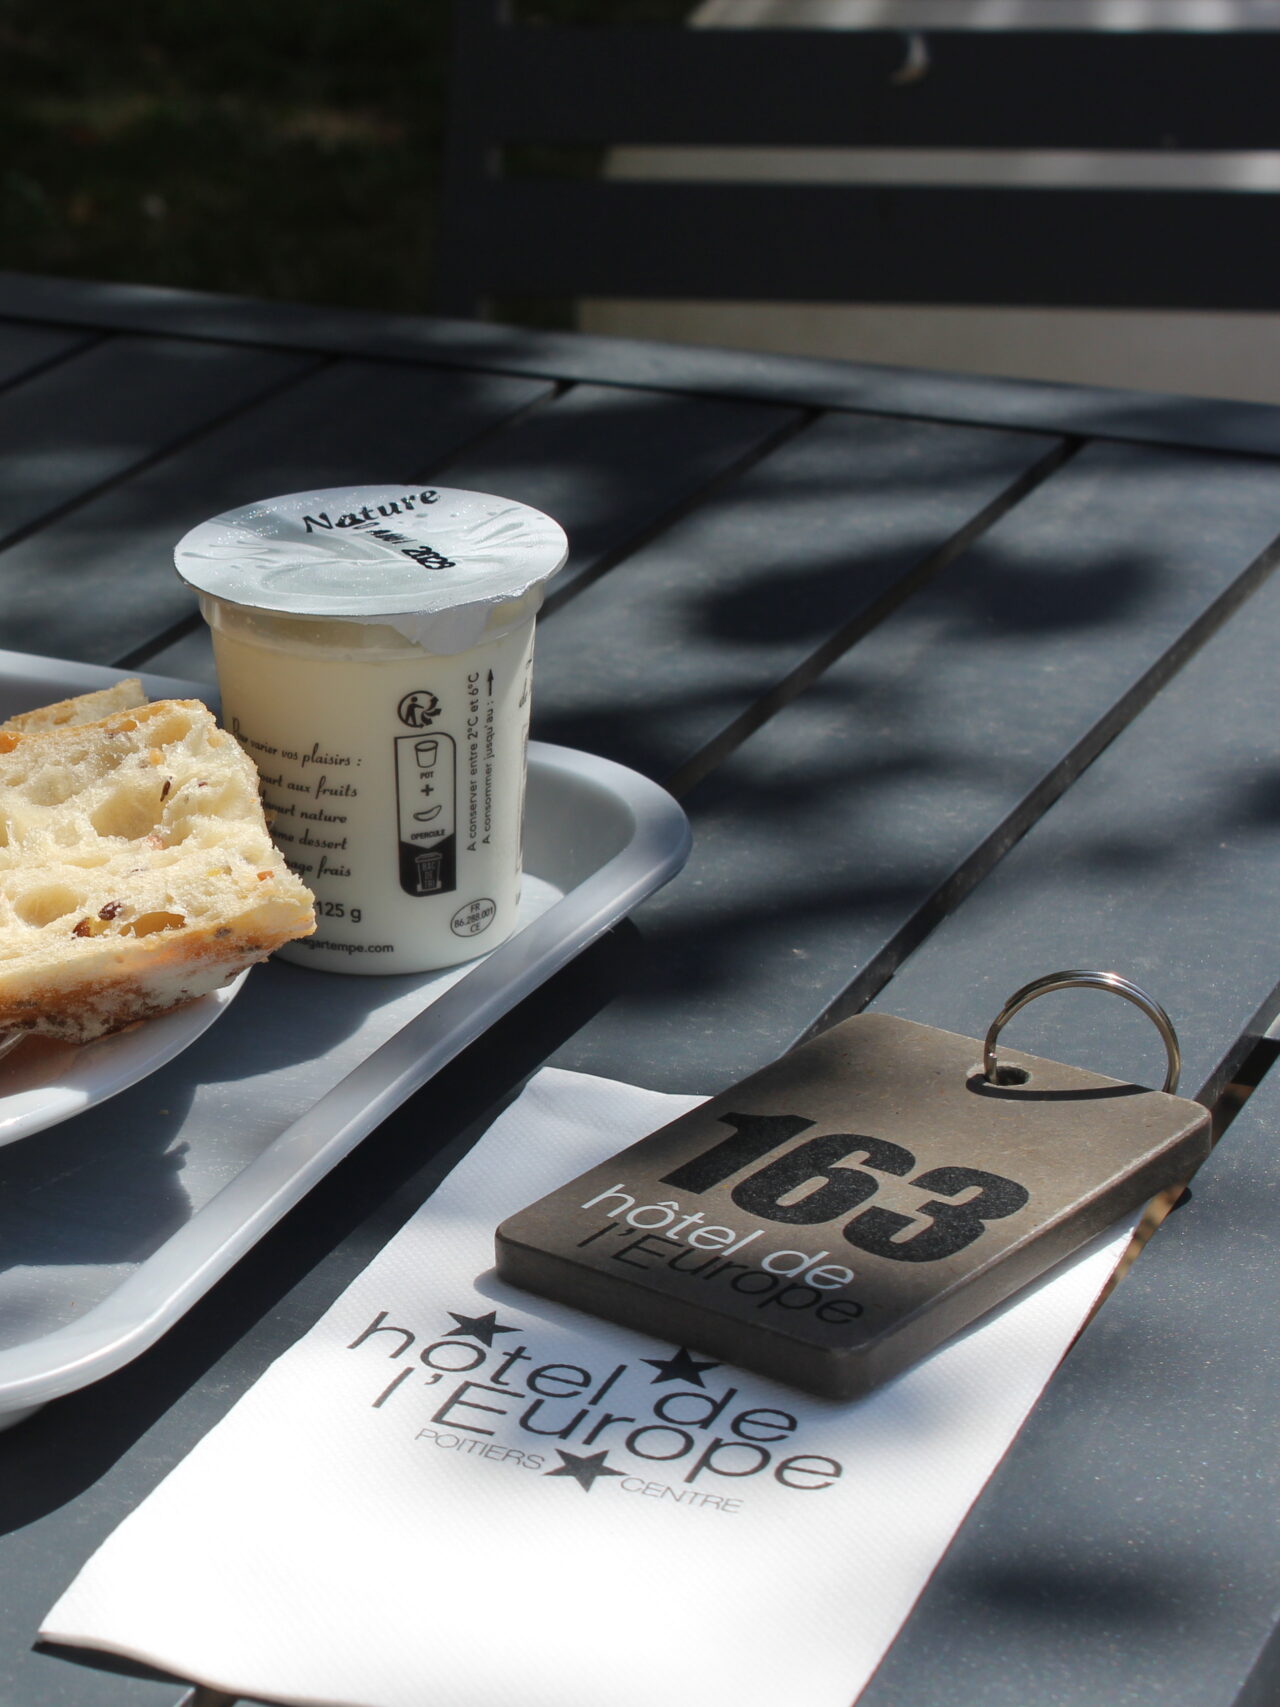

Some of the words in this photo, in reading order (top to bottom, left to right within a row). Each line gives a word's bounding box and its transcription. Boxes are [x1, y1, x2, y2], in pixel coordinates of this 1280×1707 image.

[302, 490, 439, 533] Nature
[467, 671, 479, 696] 6°C
[469, 699, 479, 713] et
[467, 716, 479, 741] 2°C
[483, 708, 496, 759] jusqu'au
[251, 739, 278, 755] varier
[281, 750, 298, 760] vos
[302, 743, 351, 767] plaisirs
[468, 742, 478, 776] entre
[420, 771, 434, 779] POT
[288, 782, 310, 793] aux
[315, 776, 358, 800] fruits
[483, 763, 493, 832] consommer
[300, 808, 348, 824] nature
[468, 780, 478, 839] conserver
[298, 829, 348, 850] dessert
[411, 829, 445, 840] OPERCULE
[467, 841, 478, 852] A
[482, 834, 491, 845] A
[317, 856, 352, 879] frais
[315, 901, 345, 918] 125
[351, 908, 362, 923] g
[471, 903, 480, 913] FR
[470, 922, 481, 932] CE
[658, 1111, 1030, 1263] 163
[581, 1183, 766, 1257] hôtel
[760, 1250, 855, 1291] de
[577, 1221, 863, 1325] l'Europe
[653, 1387, 798, 1442] de
[372, 1366, 843, 1490] l'Europe
[414, 1428, 546, 1470] POITIERS
[620, 1476, 744, 1514] CENTRE
